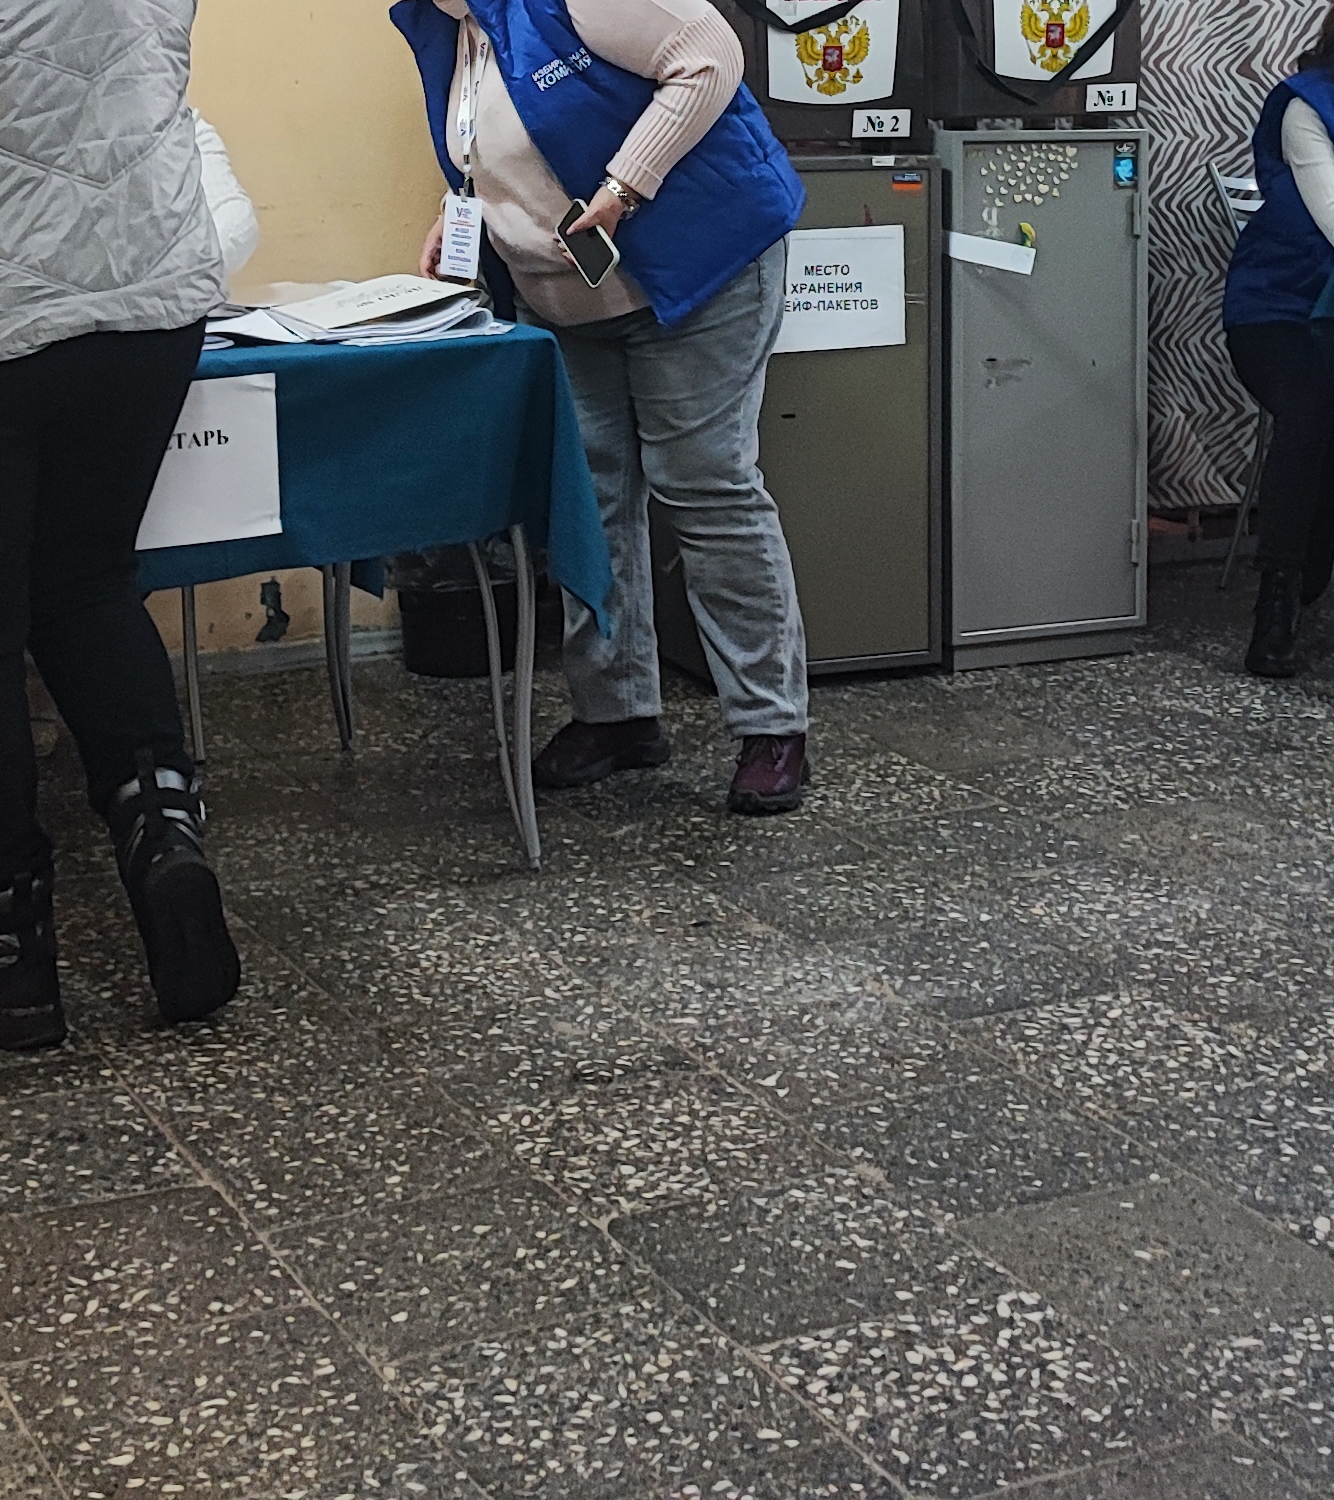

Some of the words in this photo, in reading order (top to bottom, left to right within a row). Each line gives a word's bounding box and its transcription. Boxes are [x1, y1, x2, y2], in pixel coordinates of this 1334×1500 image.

[1121, 90, 1126, 106] 1
[890, 115, 899, 132] 2
[804, 265, 850, 276] МЕСТО
[791, 282, 863, 294] ХРАНЕНИЯ
[784, 298, 879, 312] ЕЙФ-ПАКЕТОВ
[167, 429, 229, 450] ТАРЬ
